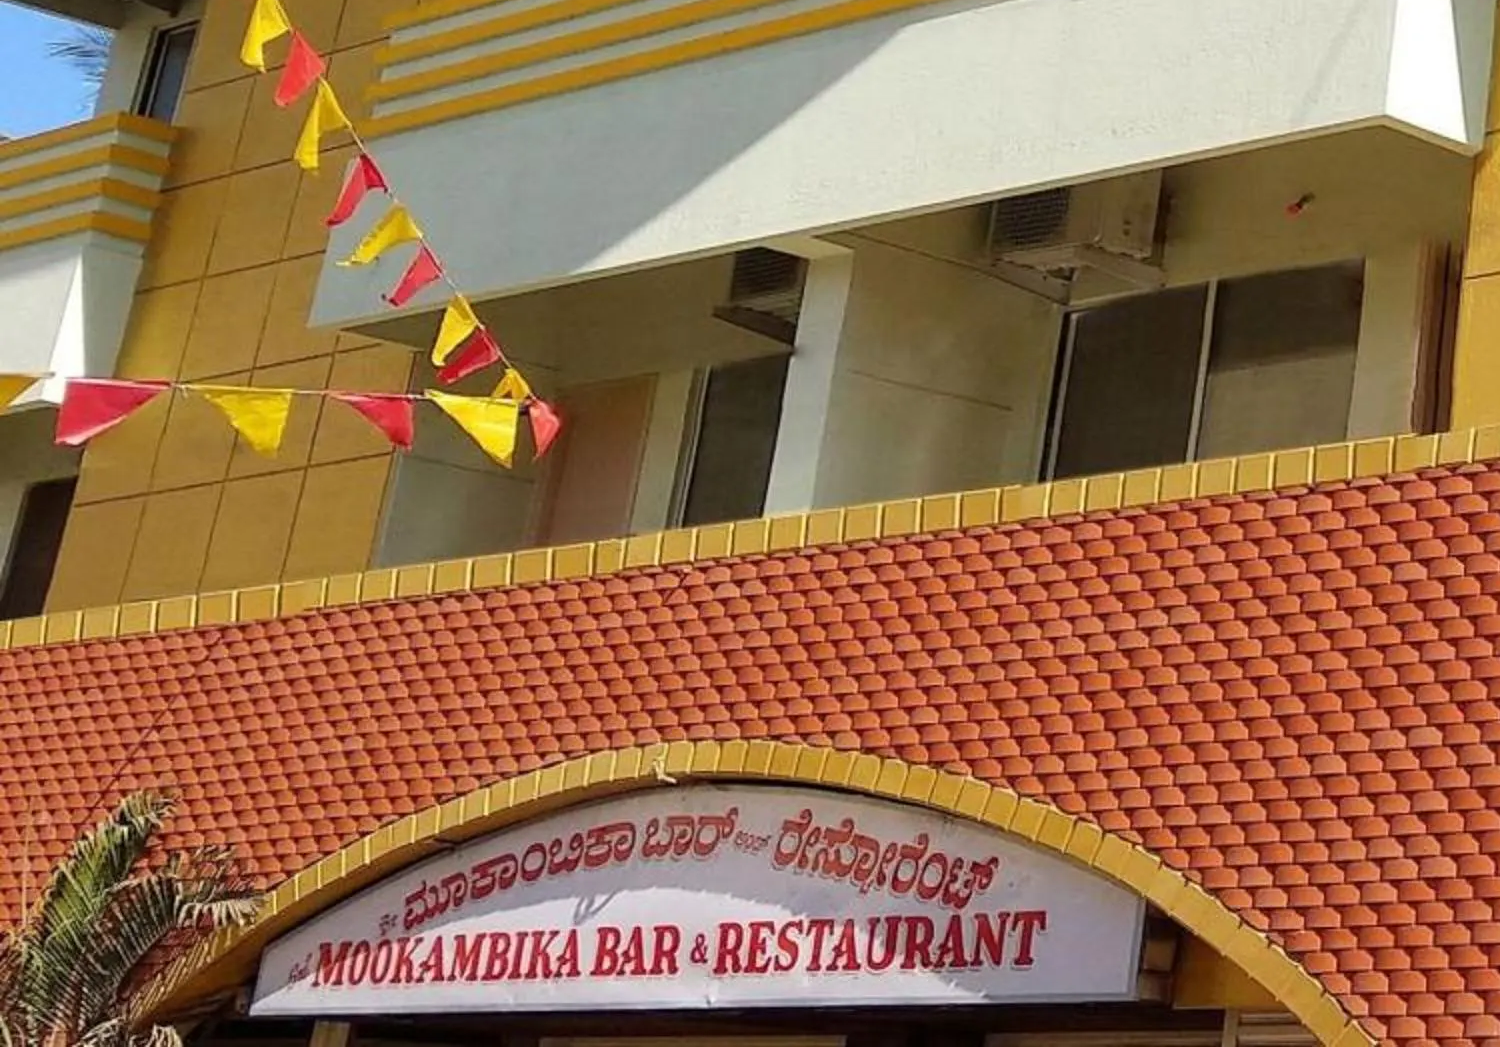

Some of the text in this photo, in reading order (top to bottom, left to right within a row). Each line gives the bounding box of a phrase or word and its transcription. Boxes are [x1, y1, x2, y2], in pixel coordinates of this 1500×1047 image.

[642, 806, 739, 858] ಬಾರ್
[311, 928, 581, 988] MOOKAMBIKA
[590, 925, 681, 976] BAR
[690, 933, 708, 964] &
[713, 910, 1047, 975] RESTAURANT
